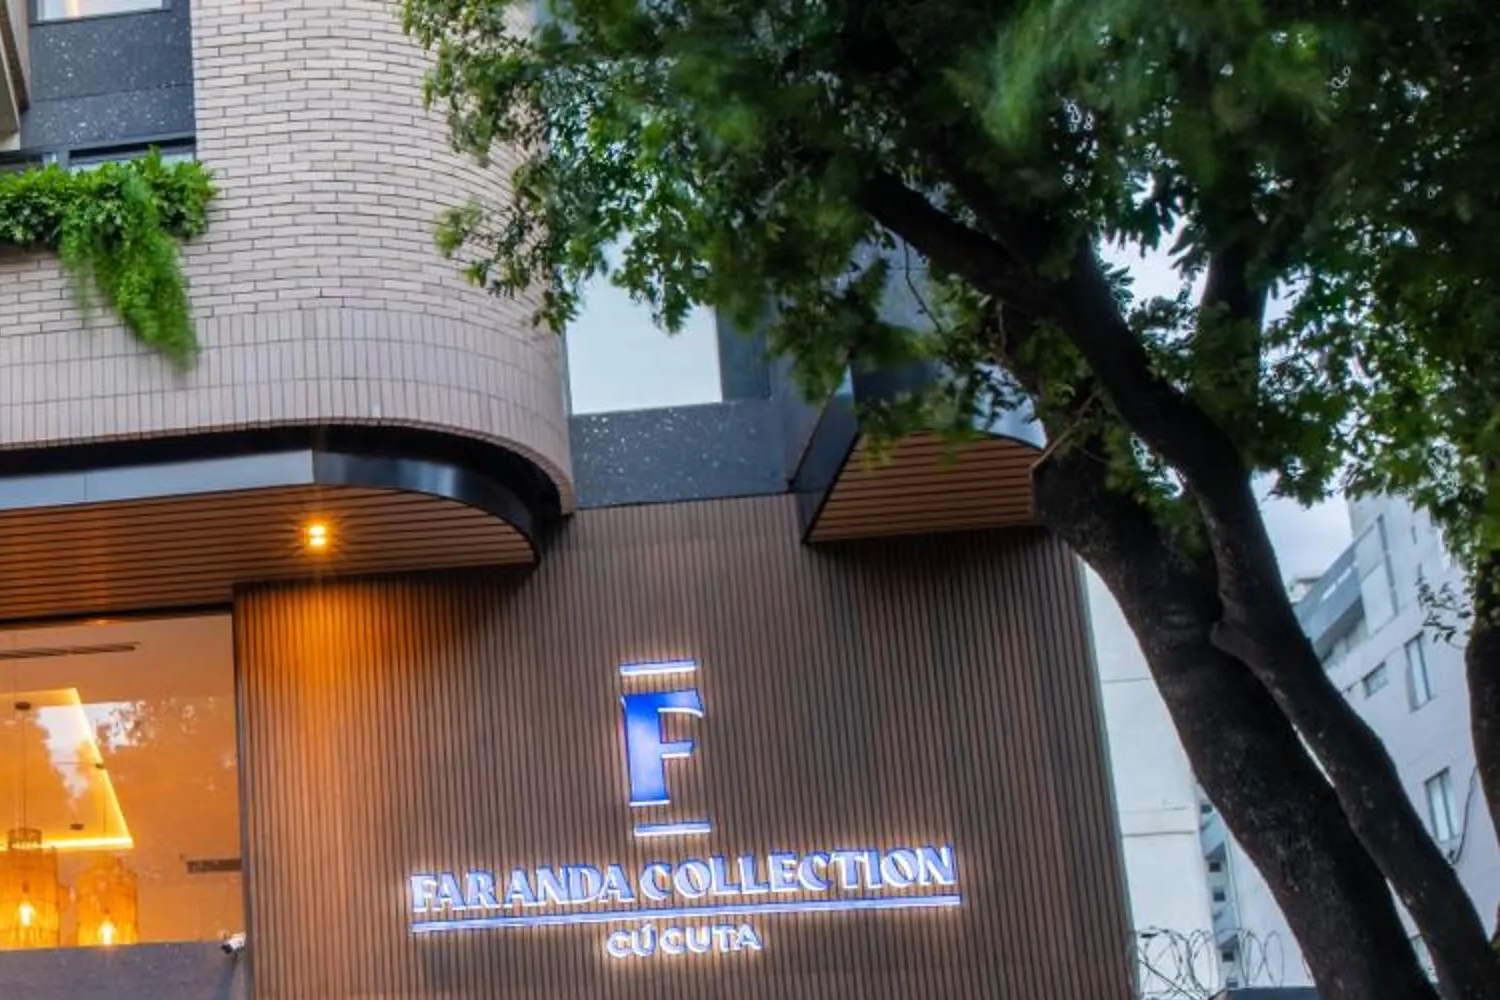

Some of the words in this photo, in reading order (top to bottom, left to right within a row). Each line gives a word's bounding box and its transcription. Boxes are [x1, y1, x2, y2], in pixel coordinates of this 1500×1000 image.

[620, 688, 705, 806] F
[409, 863, 637, 913] FARANDA
[638, 844, 957, 900] COLLECTION
[605, 922, 763, 958] CÚCUTA
